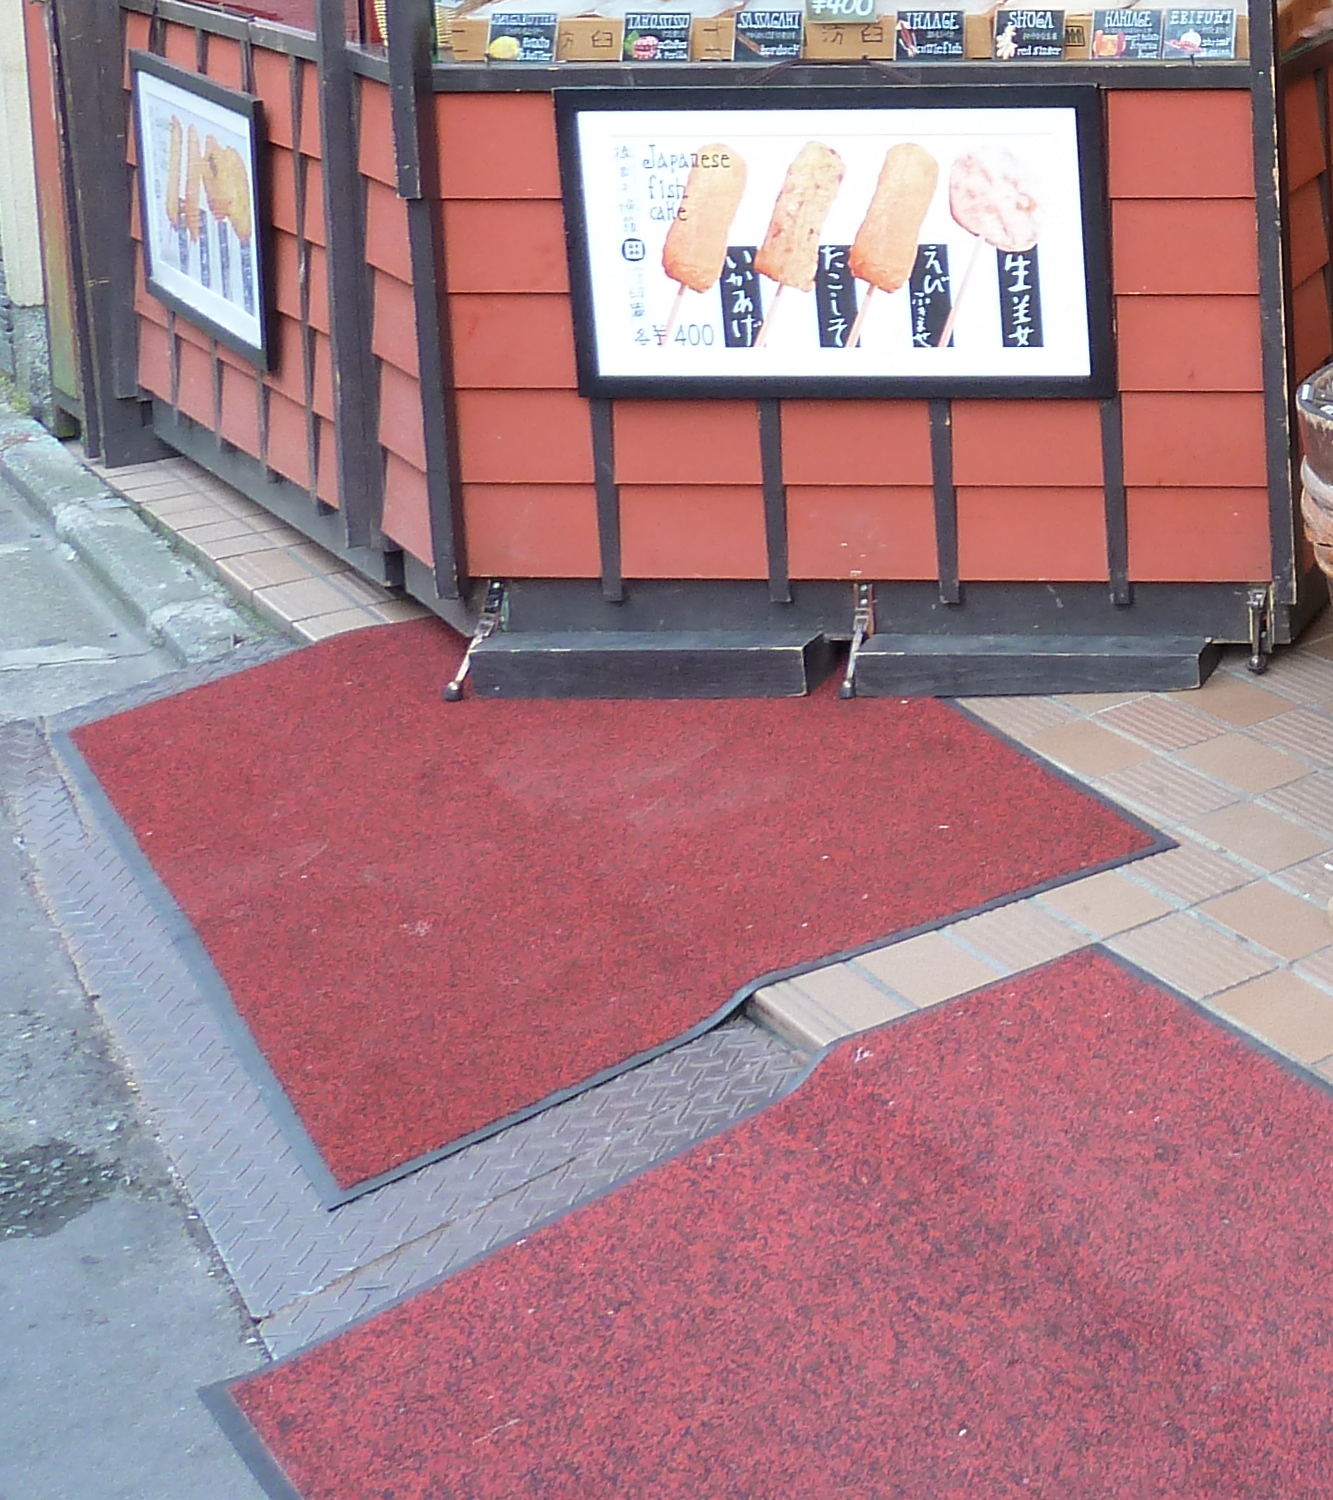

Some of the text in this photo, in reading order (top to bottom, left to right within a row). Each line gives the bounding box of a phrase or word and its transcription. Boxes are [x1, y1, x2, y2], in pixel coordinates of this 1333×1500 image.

[642, 145, 731, 174] Japanese
[648, 174, 689, 200] fish
[724, 248, 763, 347] いかあげ
[818, 245, 854, 347] たこしそ
[922, 245, 951, 293] えび
[1002, 254, 1034, 347] 生姜
